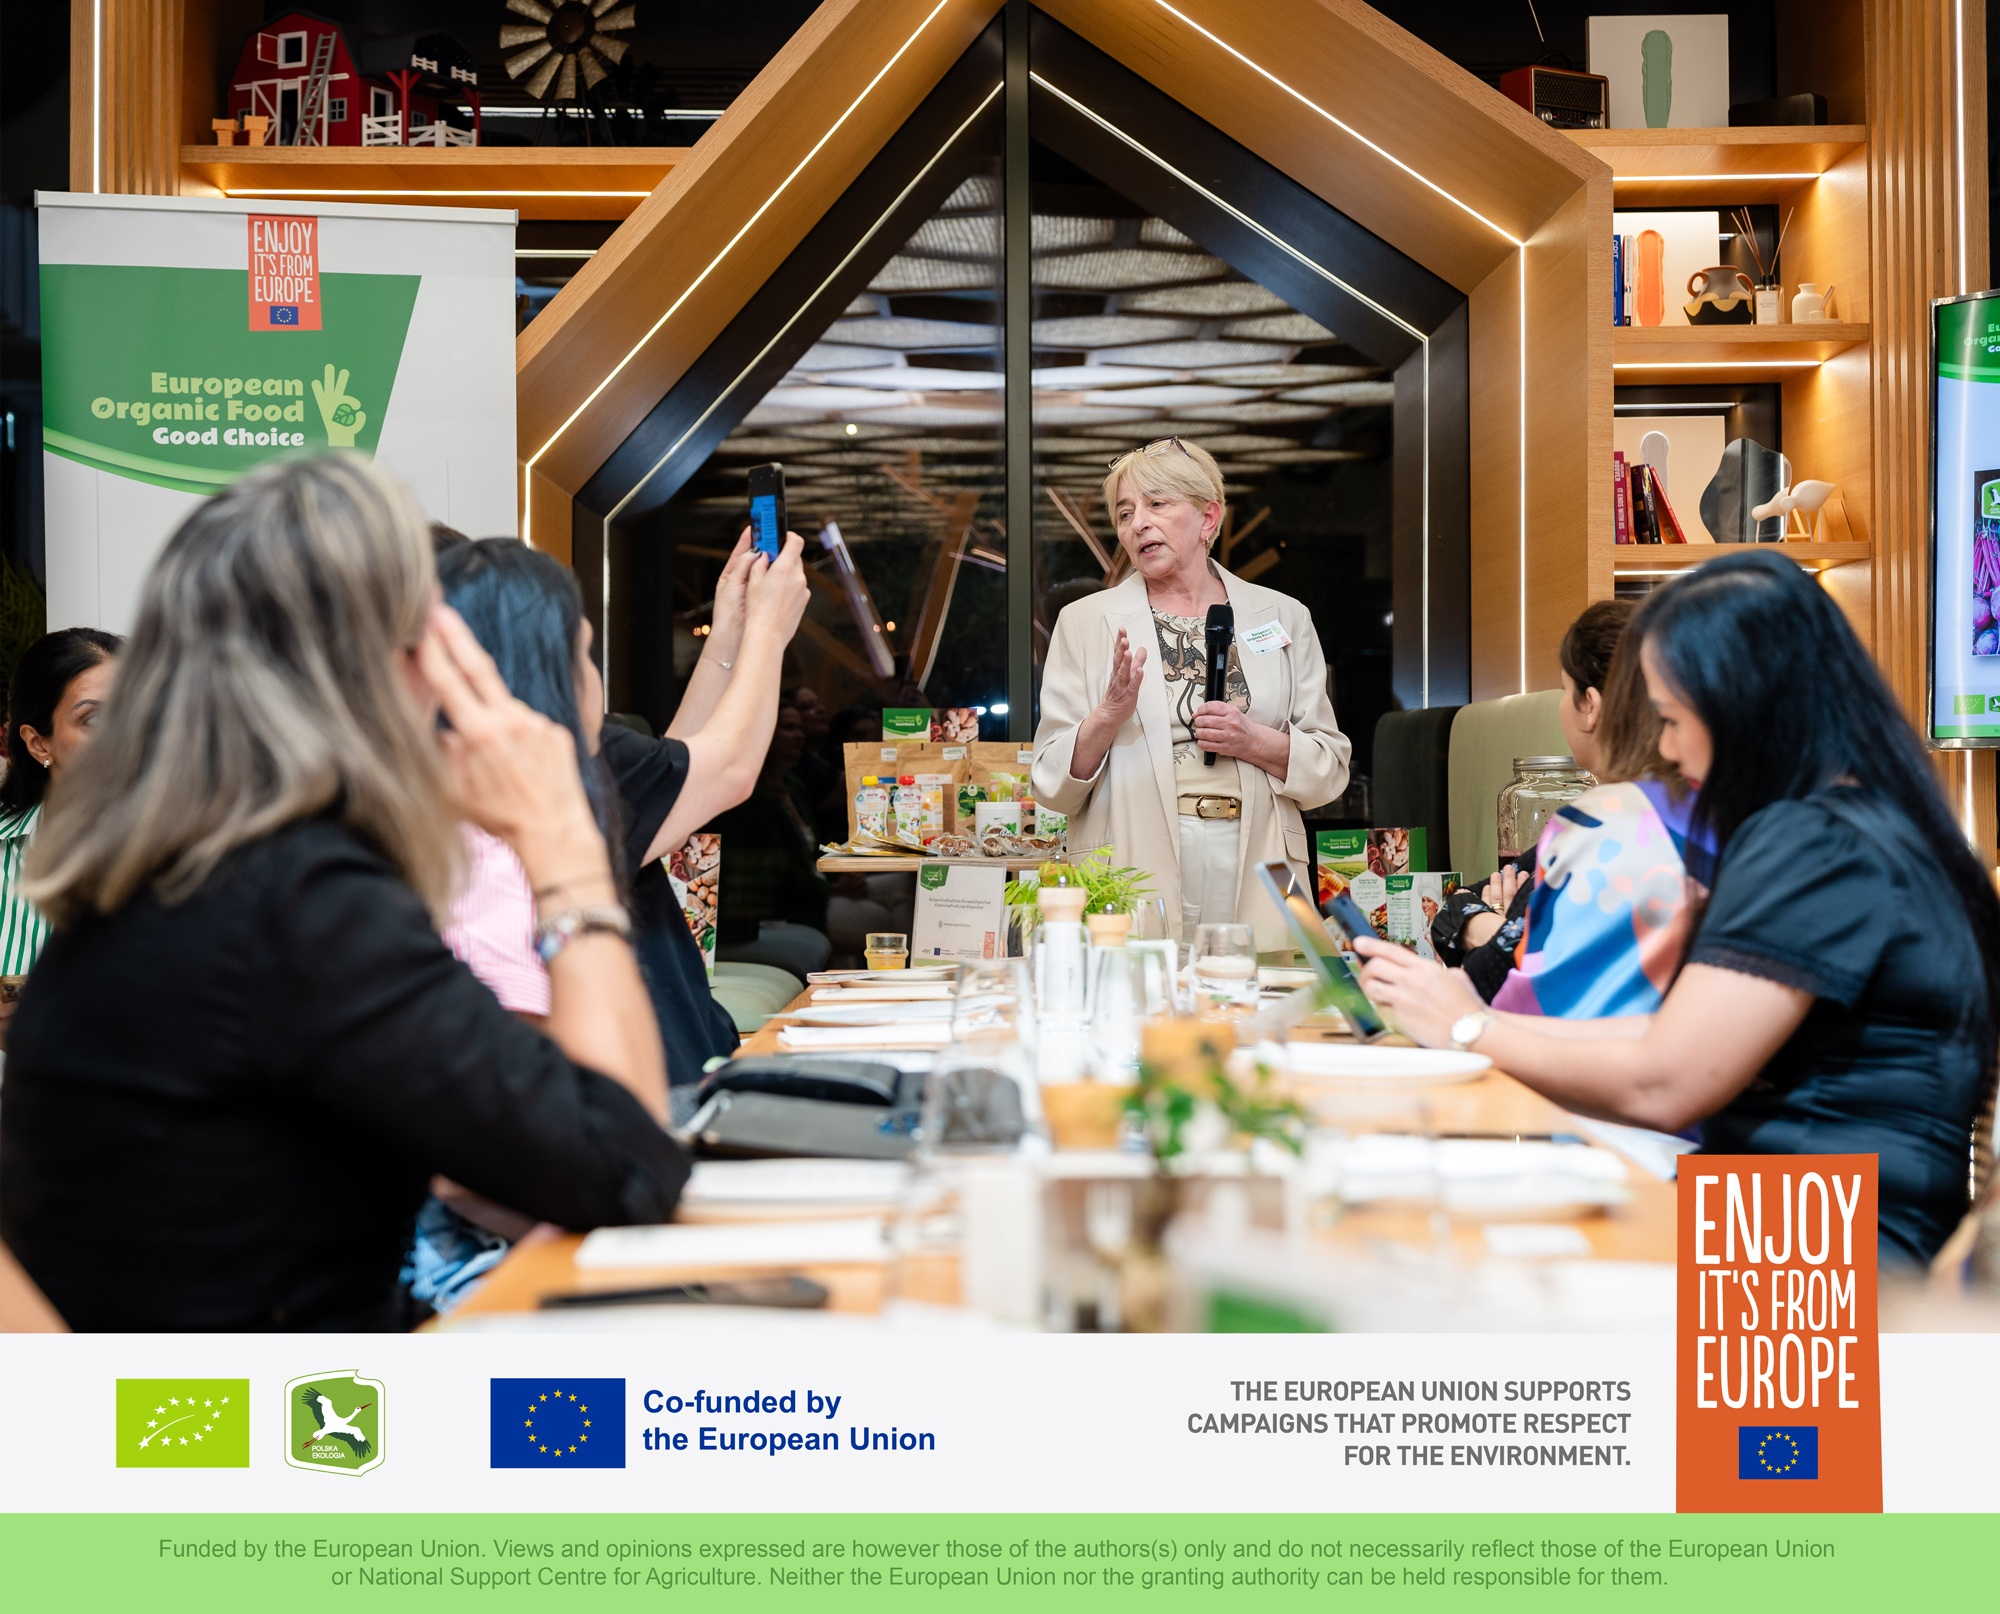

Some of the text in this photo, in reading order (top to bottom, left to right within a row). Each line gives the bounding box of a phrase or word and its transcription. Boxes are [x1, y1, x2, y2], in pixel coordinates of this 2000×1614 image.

[253, 220, 313, 254] ENJOY
[254, 253, 313, 277] IT'S FROM
[255, 276, 314, 303] EUROPE
[152, 372, 304, 399] European
[91, 396, 304, 426] Organic Food
[152, 427, 305, 447] Good Choice
